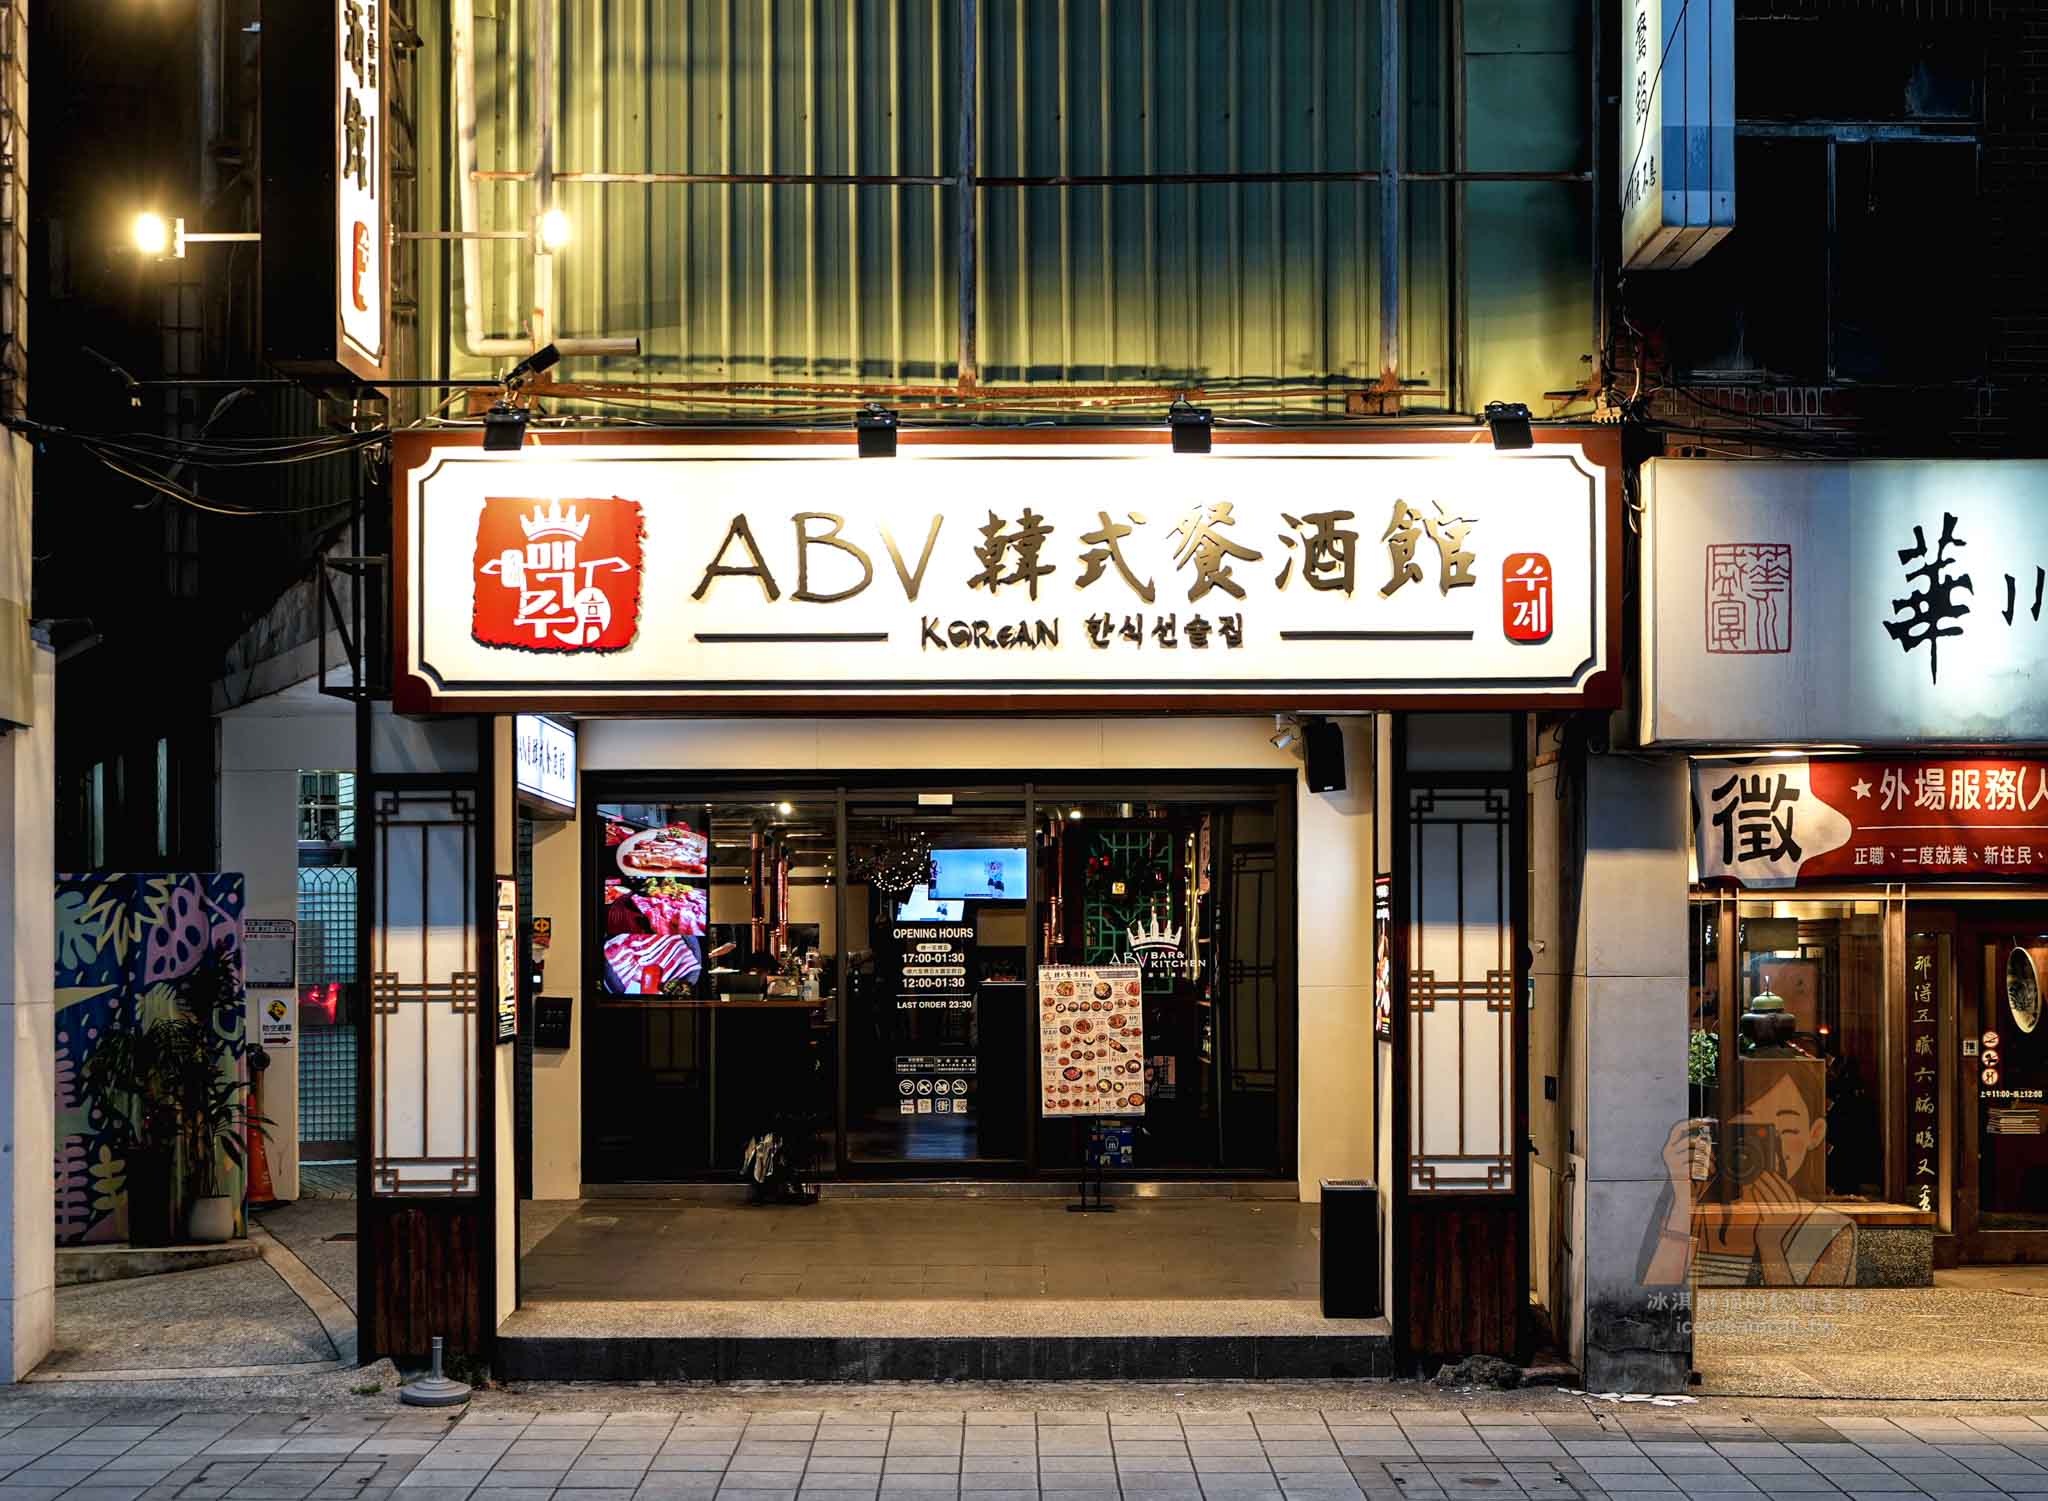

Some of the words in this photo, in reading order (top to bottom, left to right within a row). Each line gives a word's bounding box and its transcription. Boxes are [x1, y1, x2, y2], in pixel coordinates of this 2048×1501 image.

[691, 511, 944, 603] ABV
[966, 498, 1480, 605] 韓式餐酒館
[1505, 556, 1549, 633] 수제
[1086, 612, 1245, 650] 한식선술집
[1711, 773, 1803, 866] 徵
[893, 928, 937, 939] OPENING
[939, 928, 974, 938] HOURS
[902, 953, 965, 963] 17:00-01:30
[1151, 960, 1206, 968] KITCHEN
[902, 978, 965, 988] 12:00-01:30
[918, 1001, 947, 1009] ORDER
[948, 1000, 972, 1009] 23:30
